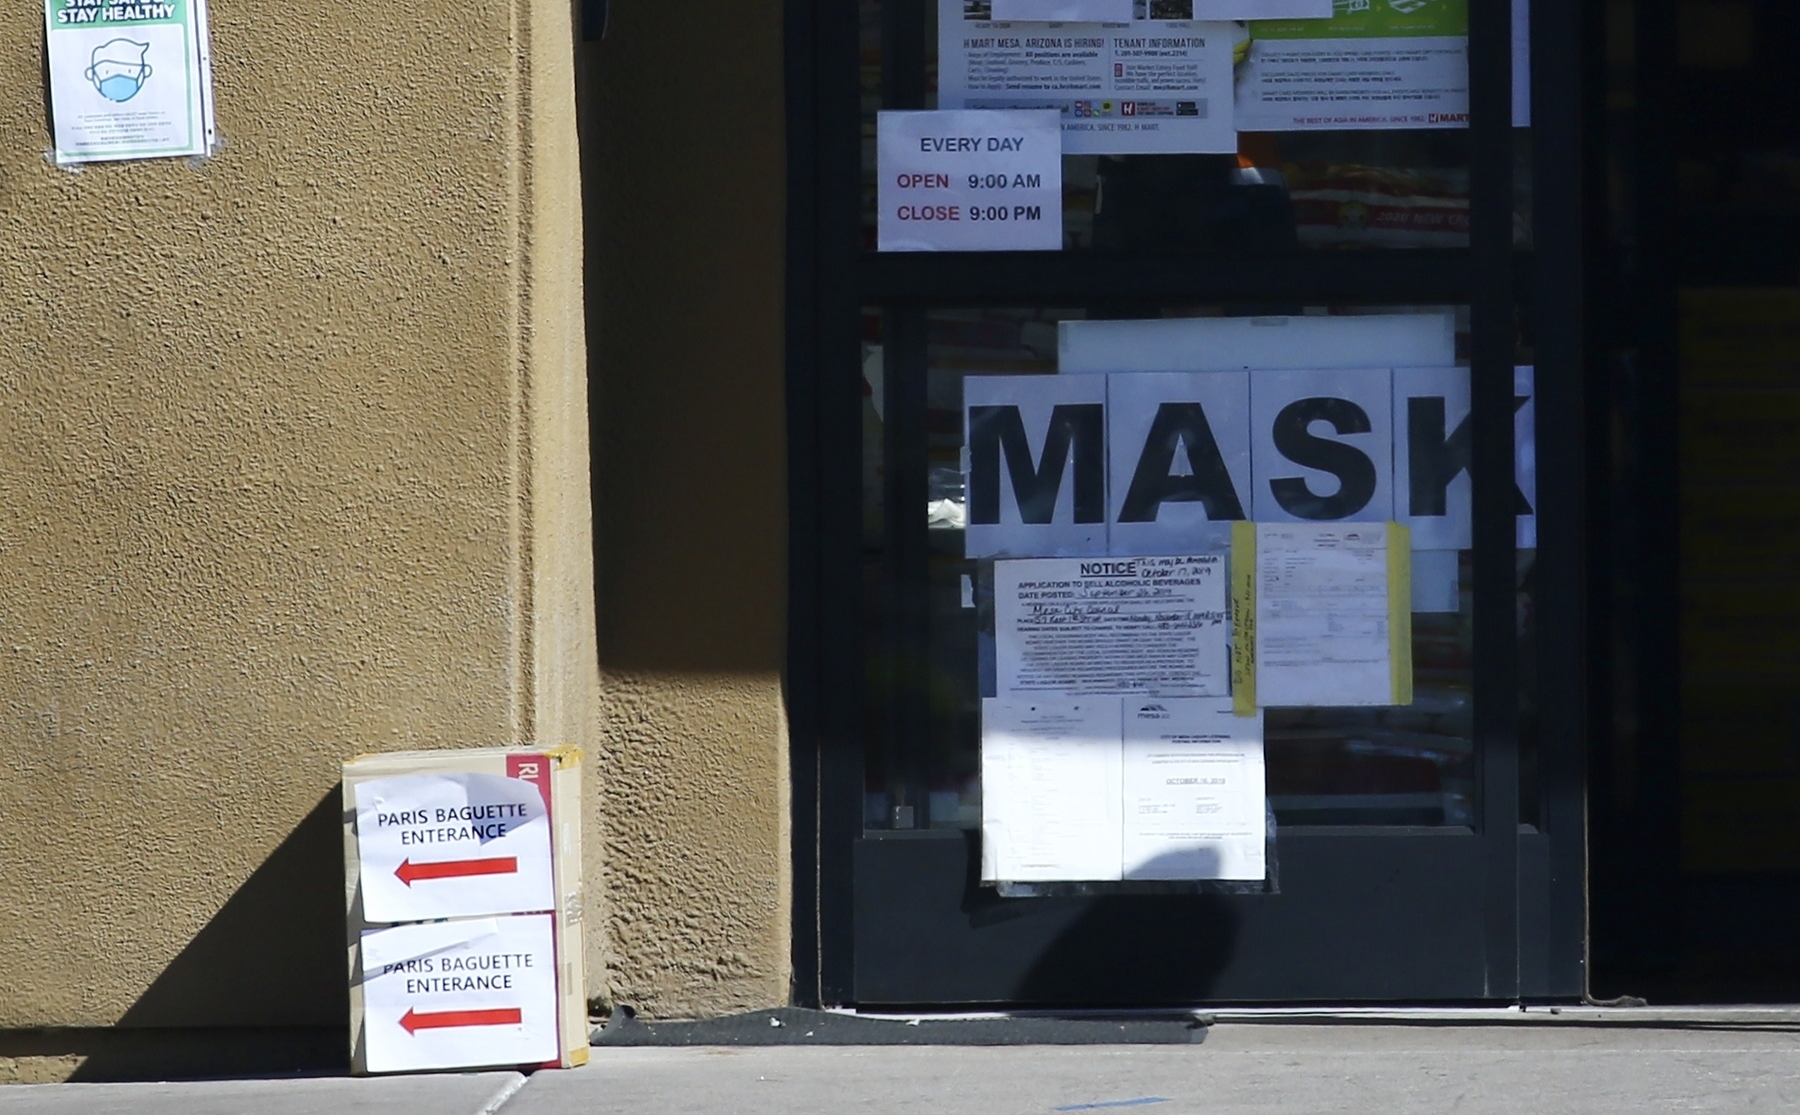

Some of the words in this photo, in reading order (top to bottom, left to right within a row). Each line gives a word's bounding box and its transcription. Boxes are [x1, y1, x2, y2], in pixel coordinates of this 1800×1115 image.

[57, 7, 100, 23] STAY
[101, 4, 176, 22] HEALTHY
[971, 38, 995, 48] MART
[1025, 38, 1063, 48] ARIZONA
[1064, 38, 1073, 48] IS
[1074, 38, 1105, 48] HIRING!
[1113, 38, 1146, 48] TENANT
[1149, 38, 1205, 48] INFORMATION
[920, 138, 982, 152] EVERY
[986, 137, 1024, 152] DAY
[897, 174, 949, 189] OPEN
[968, 173, 1008, 189] 9:00
[1013, 173, 1041, 188] AM
[897, 205, 960, 221] CLOSE
[969, 205, 1009, 221] 9:00
[1013, 205, 1041, 220] PM
[968, 396, 1534, 525] MASK
[1081, 562, 1136, 575] NOTICE
[1018, 581, 1071, 589] APPLICATION
[1073, 580, 1083, 588] TO
[1084, 580, 1103, 588] SELL
[1105, 579, 1151, 588] ALCOHOLIC
[1152, 578, 1201, 587] BEVERAGES
[1018, 591, 1039, 599] DATE
[378, 809, 428, 827] PARIS
[436, 803, 527, 822] BAGUETTE
[401, 823, 507, 845] ENTERANCE
[383, 958, 433, 975] PARIS
[441, 953, 533, 972] BAGUETTE
[406, 975, 512, 994] ENTERANCE
